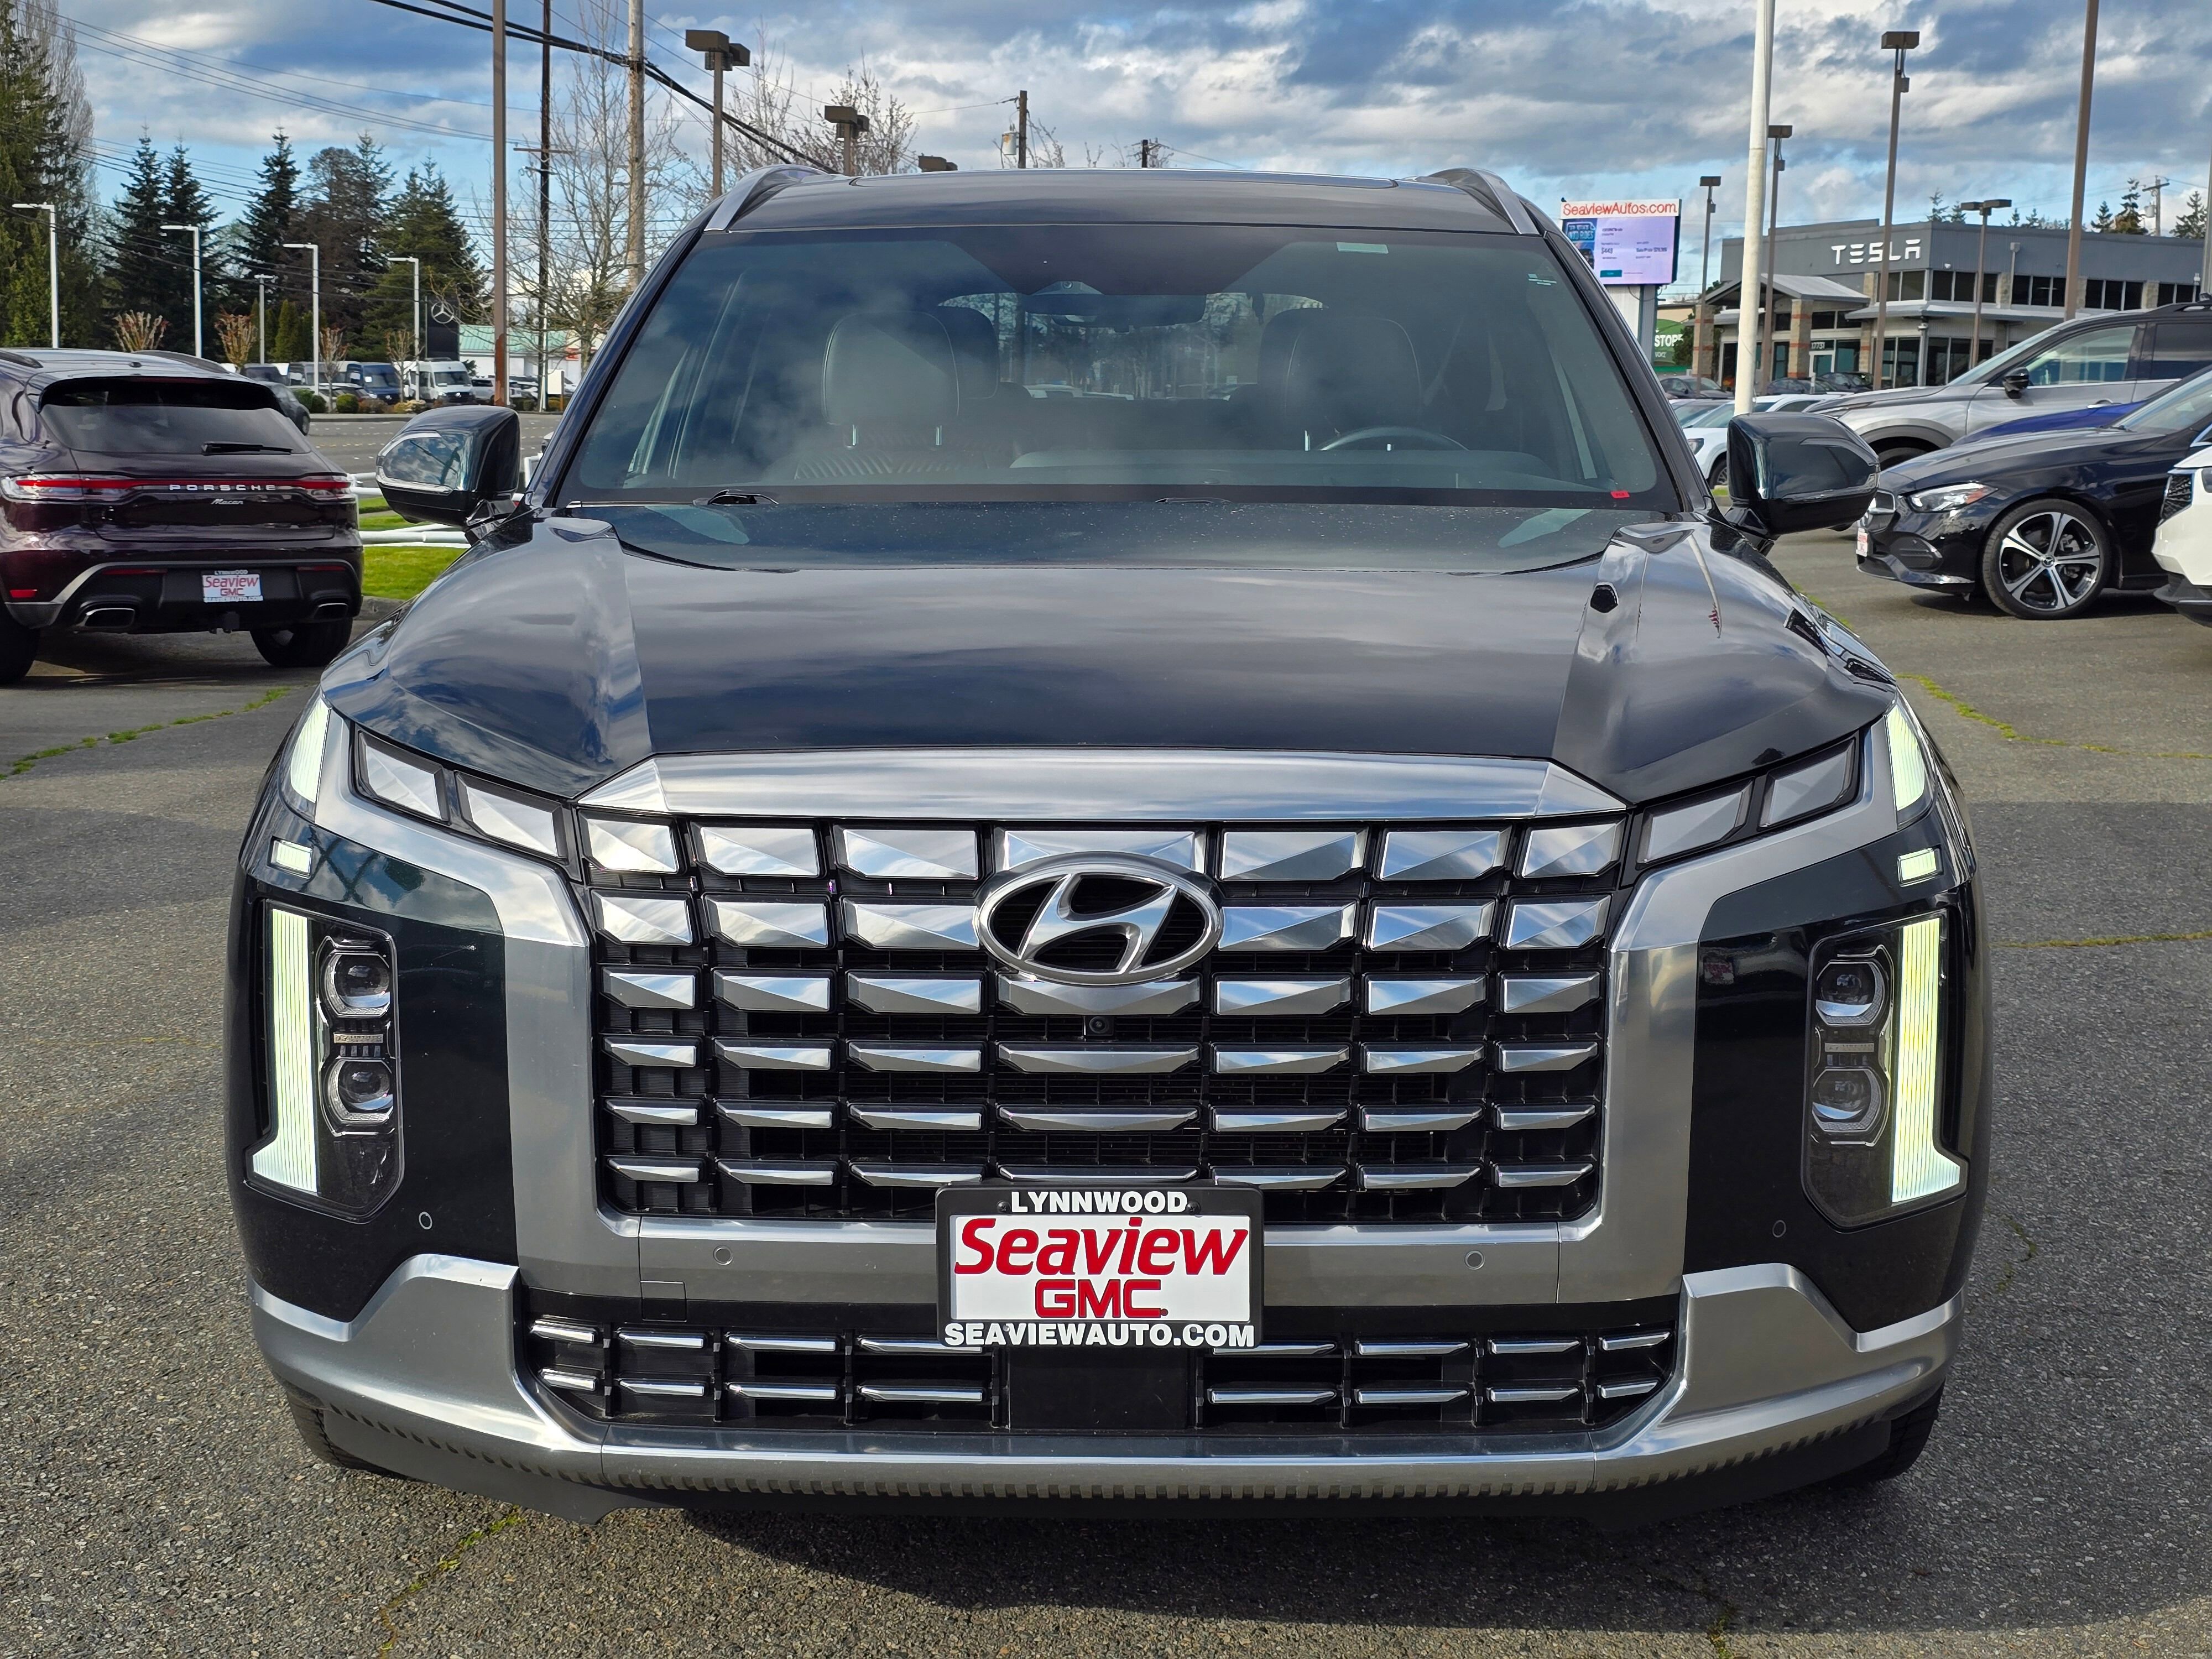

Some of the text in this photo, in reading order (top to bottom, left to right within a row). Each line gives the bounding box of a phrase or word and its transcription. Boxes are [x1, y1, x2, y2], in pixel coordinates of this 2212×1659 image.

[1563, 202, 1677, 216] SeaviewAutos.com
[1831, 239, 1921, 265] TESLA
[204, 576, 259, 588] Seaview
[220, 588, 245, 596] GMC
[1011, 1191, 1188, 1213] LYNNWOOD
[954, 1217, 1249, 1275] Seaview
[1035, 1279, 1162, 1318] GMC
[944, 1322, 1255, 1347] SEAVIEWAUTO.COM
